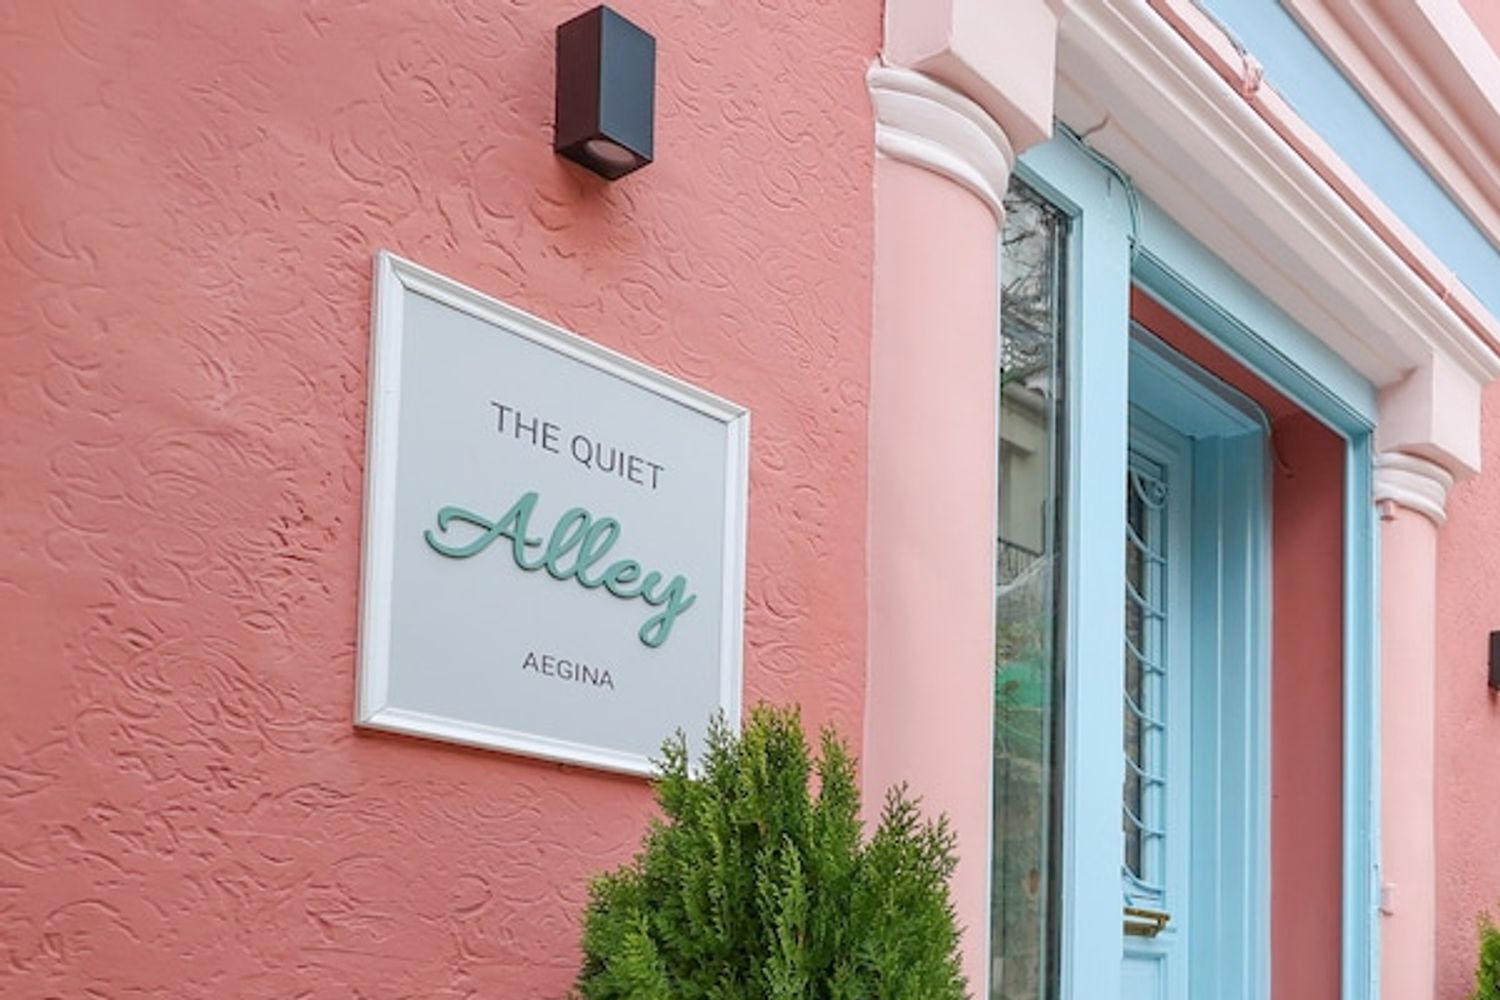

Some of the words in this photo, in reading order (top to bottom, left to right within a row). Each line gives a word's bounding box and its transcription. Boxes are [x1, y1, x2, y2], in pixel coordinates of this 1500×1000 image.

[491, 401, 560, 454] THE
[571, 434, 664, 490] QUIET
[424, 491, 697, 649] Alley
[522, 651, 614, 690] AEGINA
